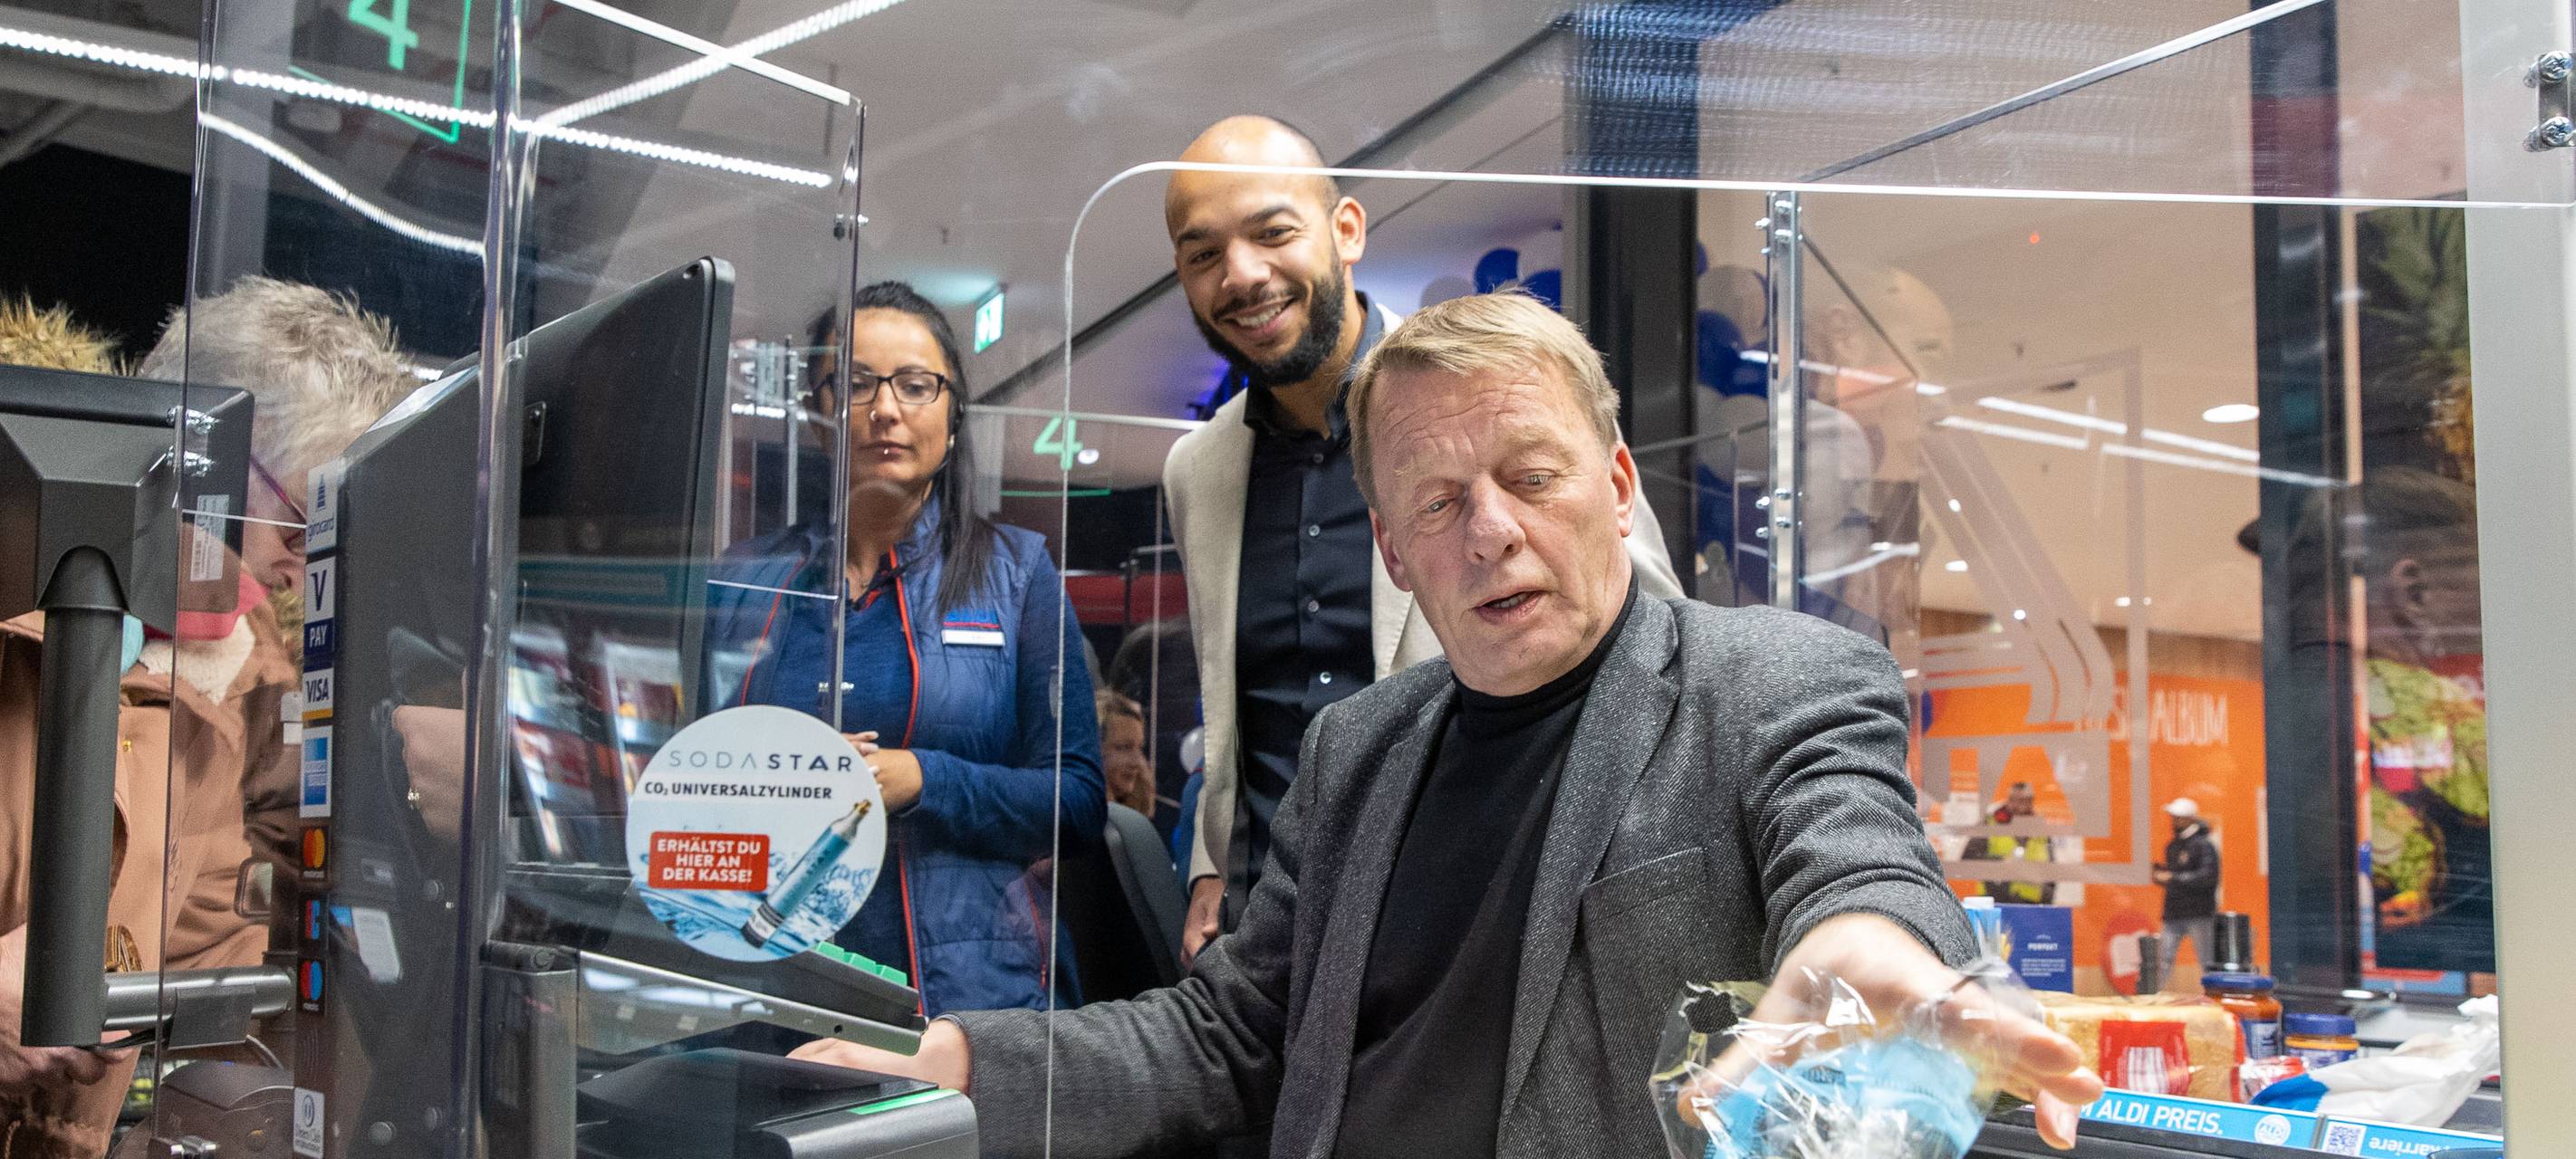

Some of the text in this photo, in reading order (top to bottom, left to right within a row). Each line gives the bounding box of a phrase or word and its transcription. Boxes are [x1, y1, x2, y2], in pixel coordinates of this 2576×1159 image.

[348, 0, 419, 70] 4
[1033, 415, 1083, 470] 4
[311, 569, 328, 612] V
[309, 624, 328, 647] PAY
[306, 676, 330, 704] VISA
[671, 782, 832, 800] UNIVERSALZYLINDER
[657, 837, 762, 856] ERHÄLTST DU
[676, 854, 741, 868] HIER AN
[662, 867, 753, 883] DER KASSE!
[2096, 1098, 2147, 1125] ALDI
[2152, 1106, 2224, 1135] PREIS.
